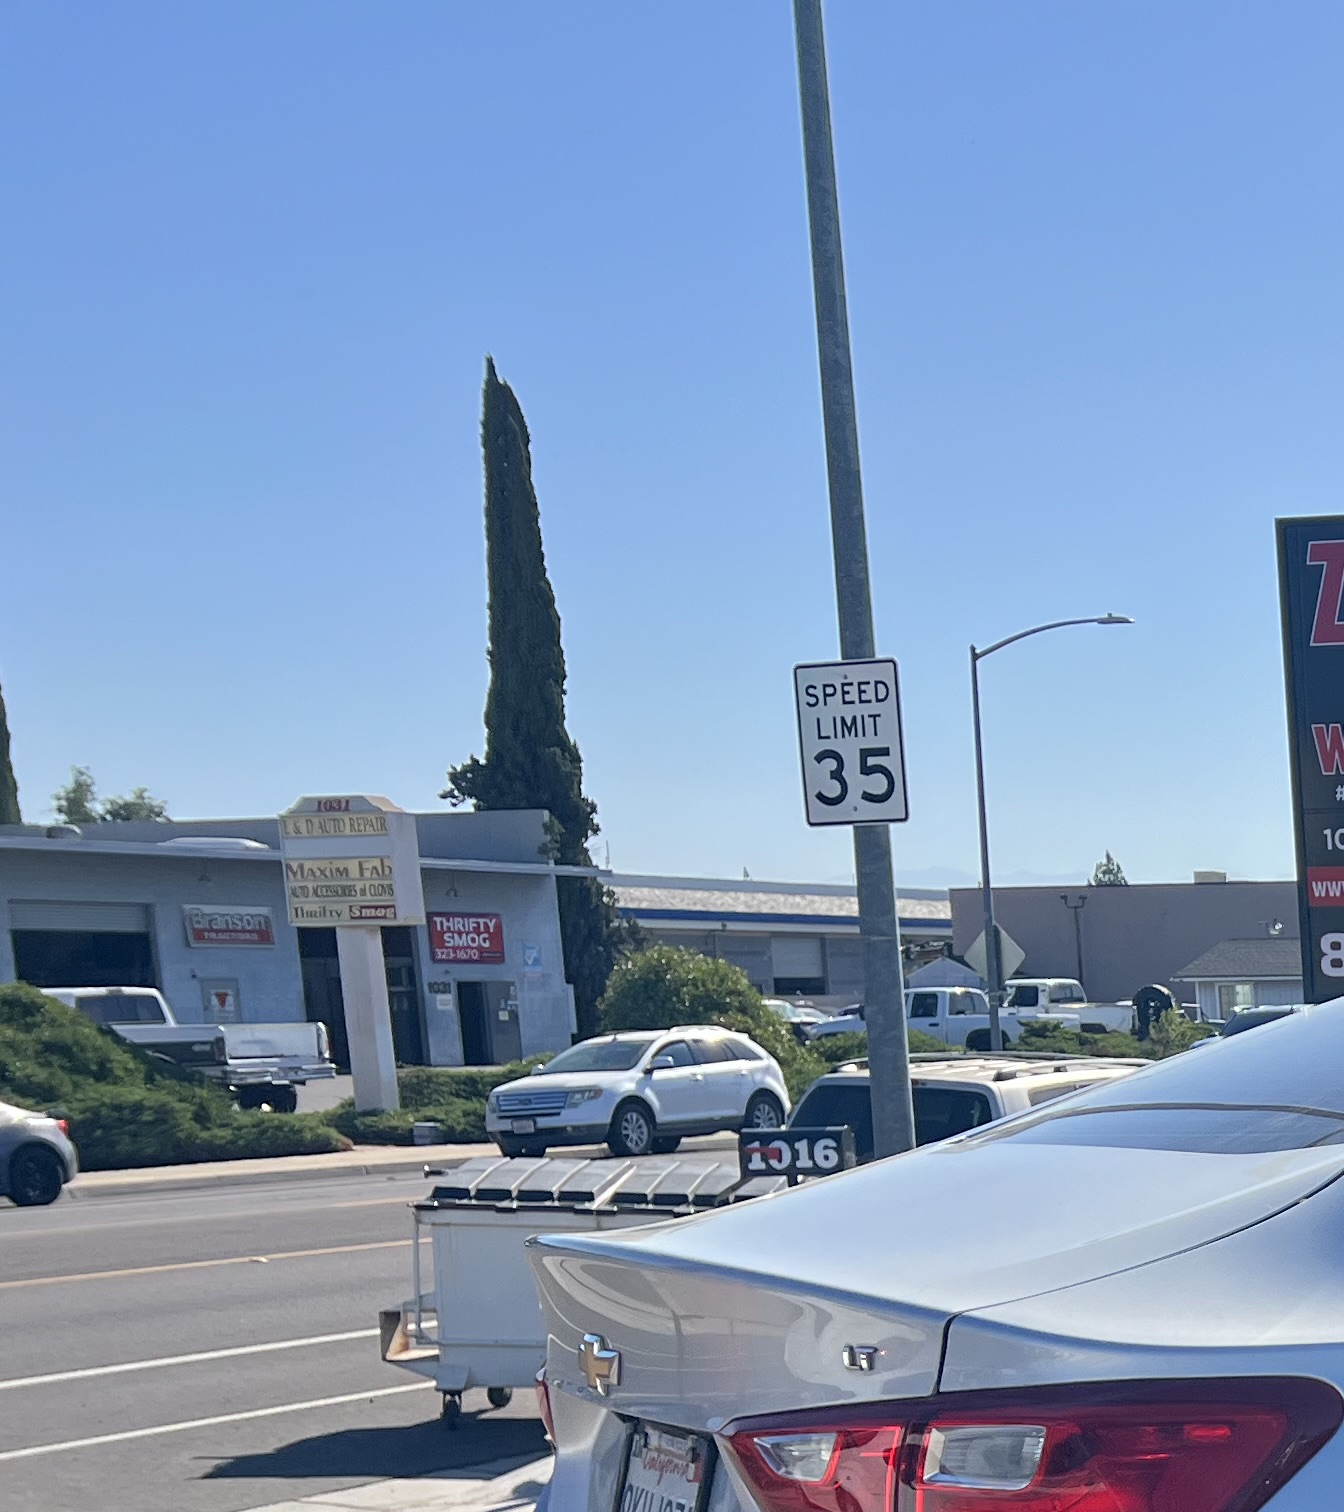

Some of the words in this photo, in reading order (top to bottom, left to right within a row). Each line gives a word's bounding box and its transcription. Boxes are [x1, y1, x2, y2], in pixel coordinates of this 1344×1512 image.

[805, 680, 889, 707] SPEED
[816, 714, 881, 740] LIMIT
[814, 746, 895, 806] 35
[317, 799, 350, 813] 1031
[293, 820, 302, 835] &
[306, 819, 314, 834] D
[318, 818, 346, 833] AUTO
[349, 815, 388, 832] REPAIR
[350, 905, 395, 918] Smog
[433, 917, 496, 932] THRIFTY
[443, 932, 490, 948] SMOG
[434, 949, 478, 960] 323-1670
[746, 1138, 839, 1171] 1016
[842, 1344, 879, 1371] LT
